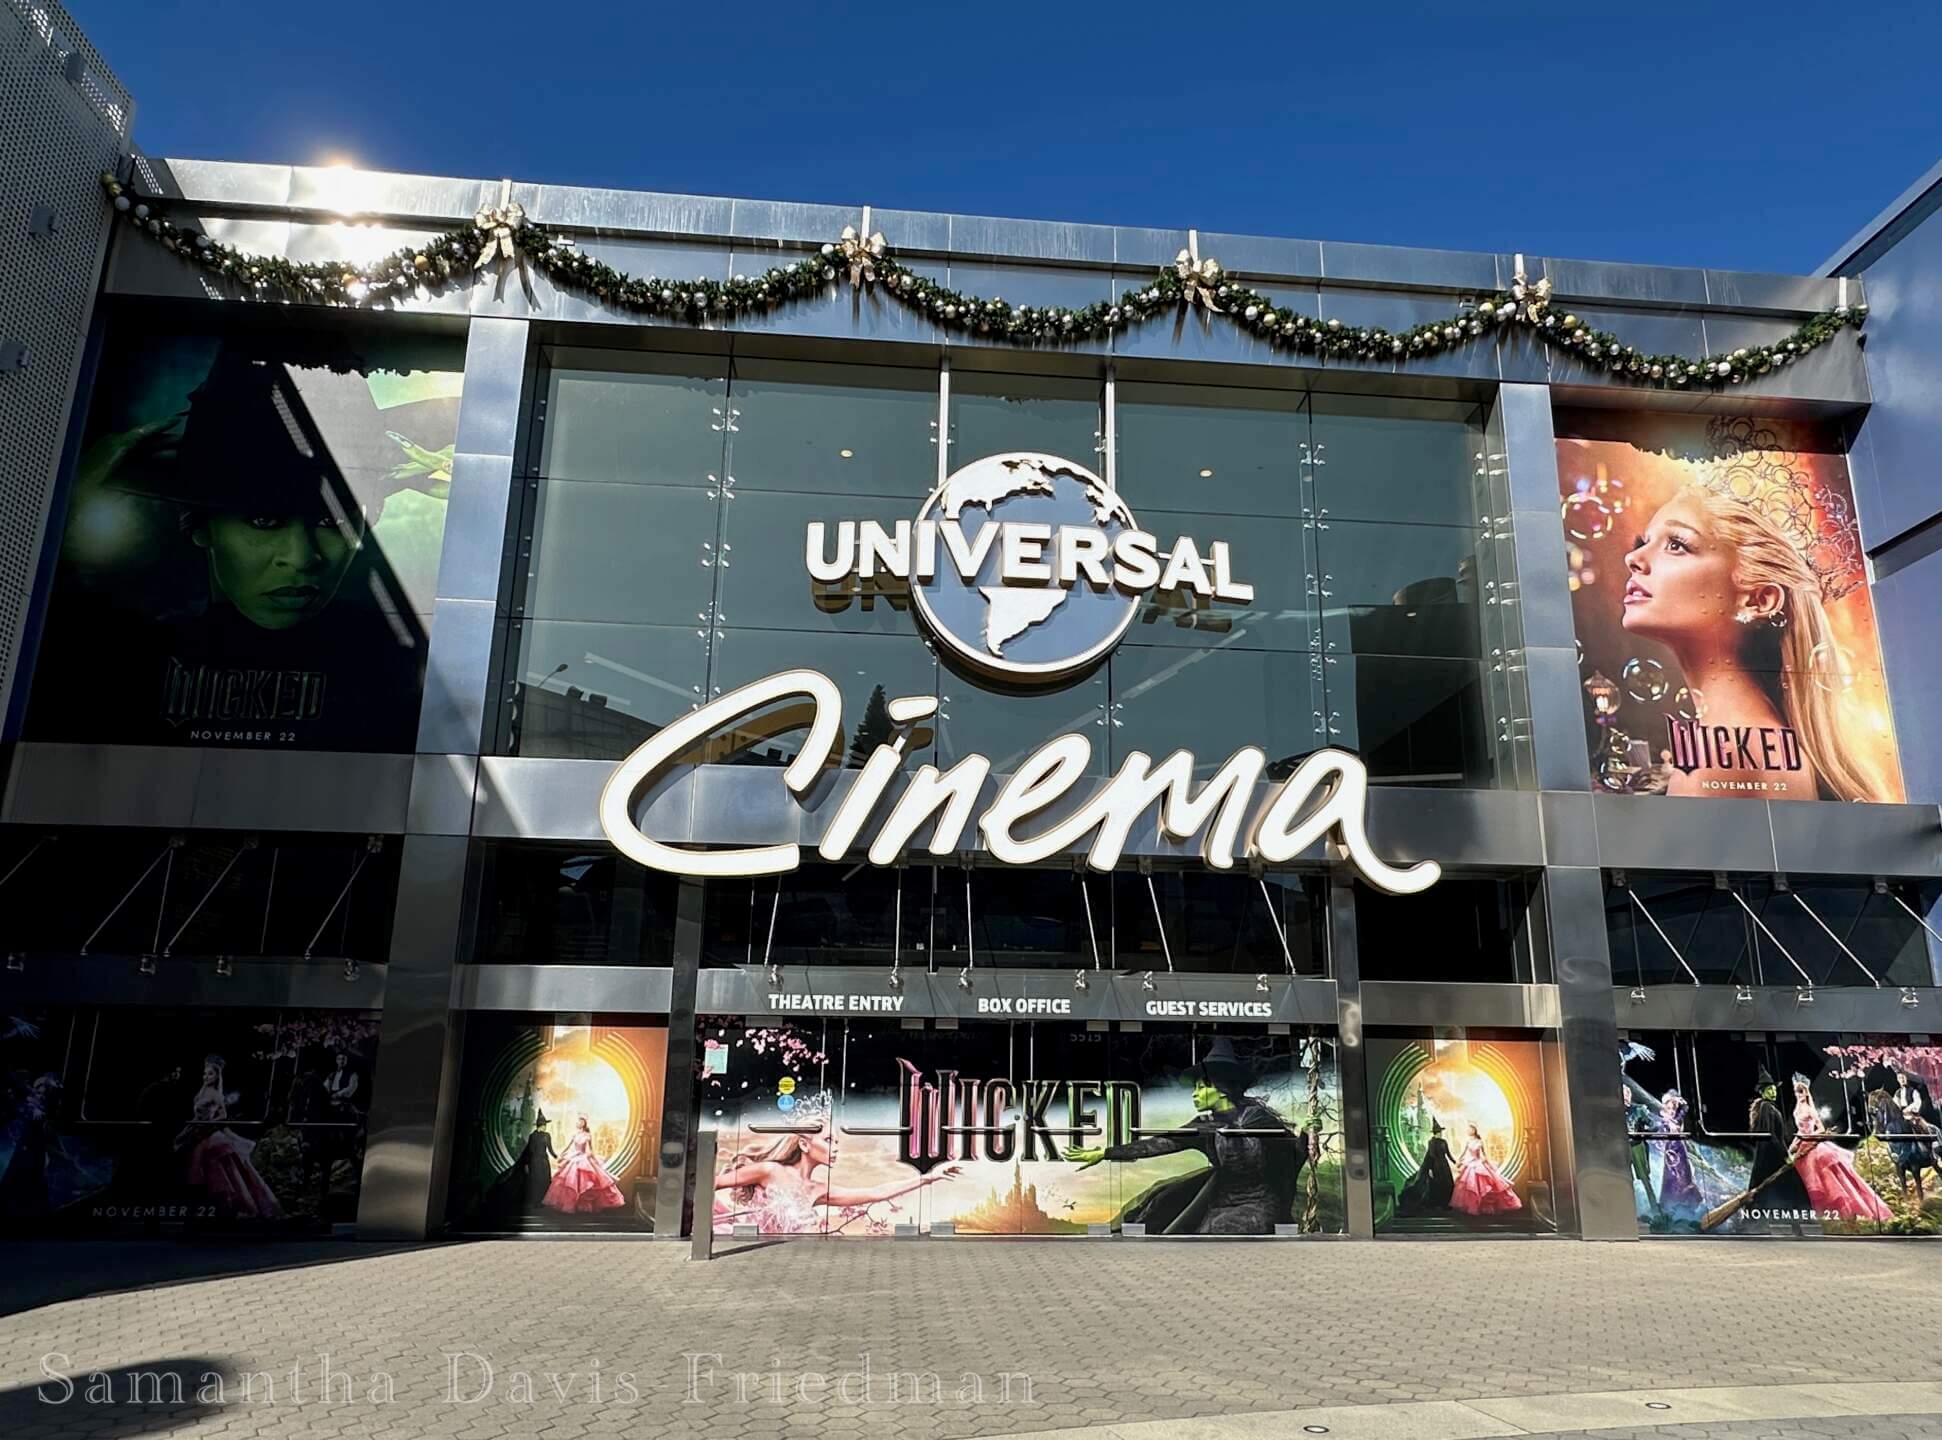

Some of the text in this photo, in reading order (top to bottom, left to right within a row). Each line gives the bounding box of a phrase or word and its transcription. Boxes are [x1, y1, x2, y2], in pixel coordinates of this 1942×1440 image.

[806, 519, 1254, 605] UNIVERSAL
[162, 656, 327, 728] WICKED
[190, 730, 296, 742] NOVEMBER 22
[1664, 714, 1802, 775] WICKED
[599, 669, 1441, 895] Cinema
[1702, 780, 1788, 792] NOVEMBER 22
[768, 993, 904, 1011] THEATRE ENTRY
[978, 998, 1071, 1014] BOX OFFICE
[1145, 1000, 1273, 1017] GUEST SERVICES
[895, 1057, 1142, 1174] WICKED
[92, 1206, 216, 1218] NOVEMBER 22
[1741, 1208, 1840, 1221] NOVEMBER 22
